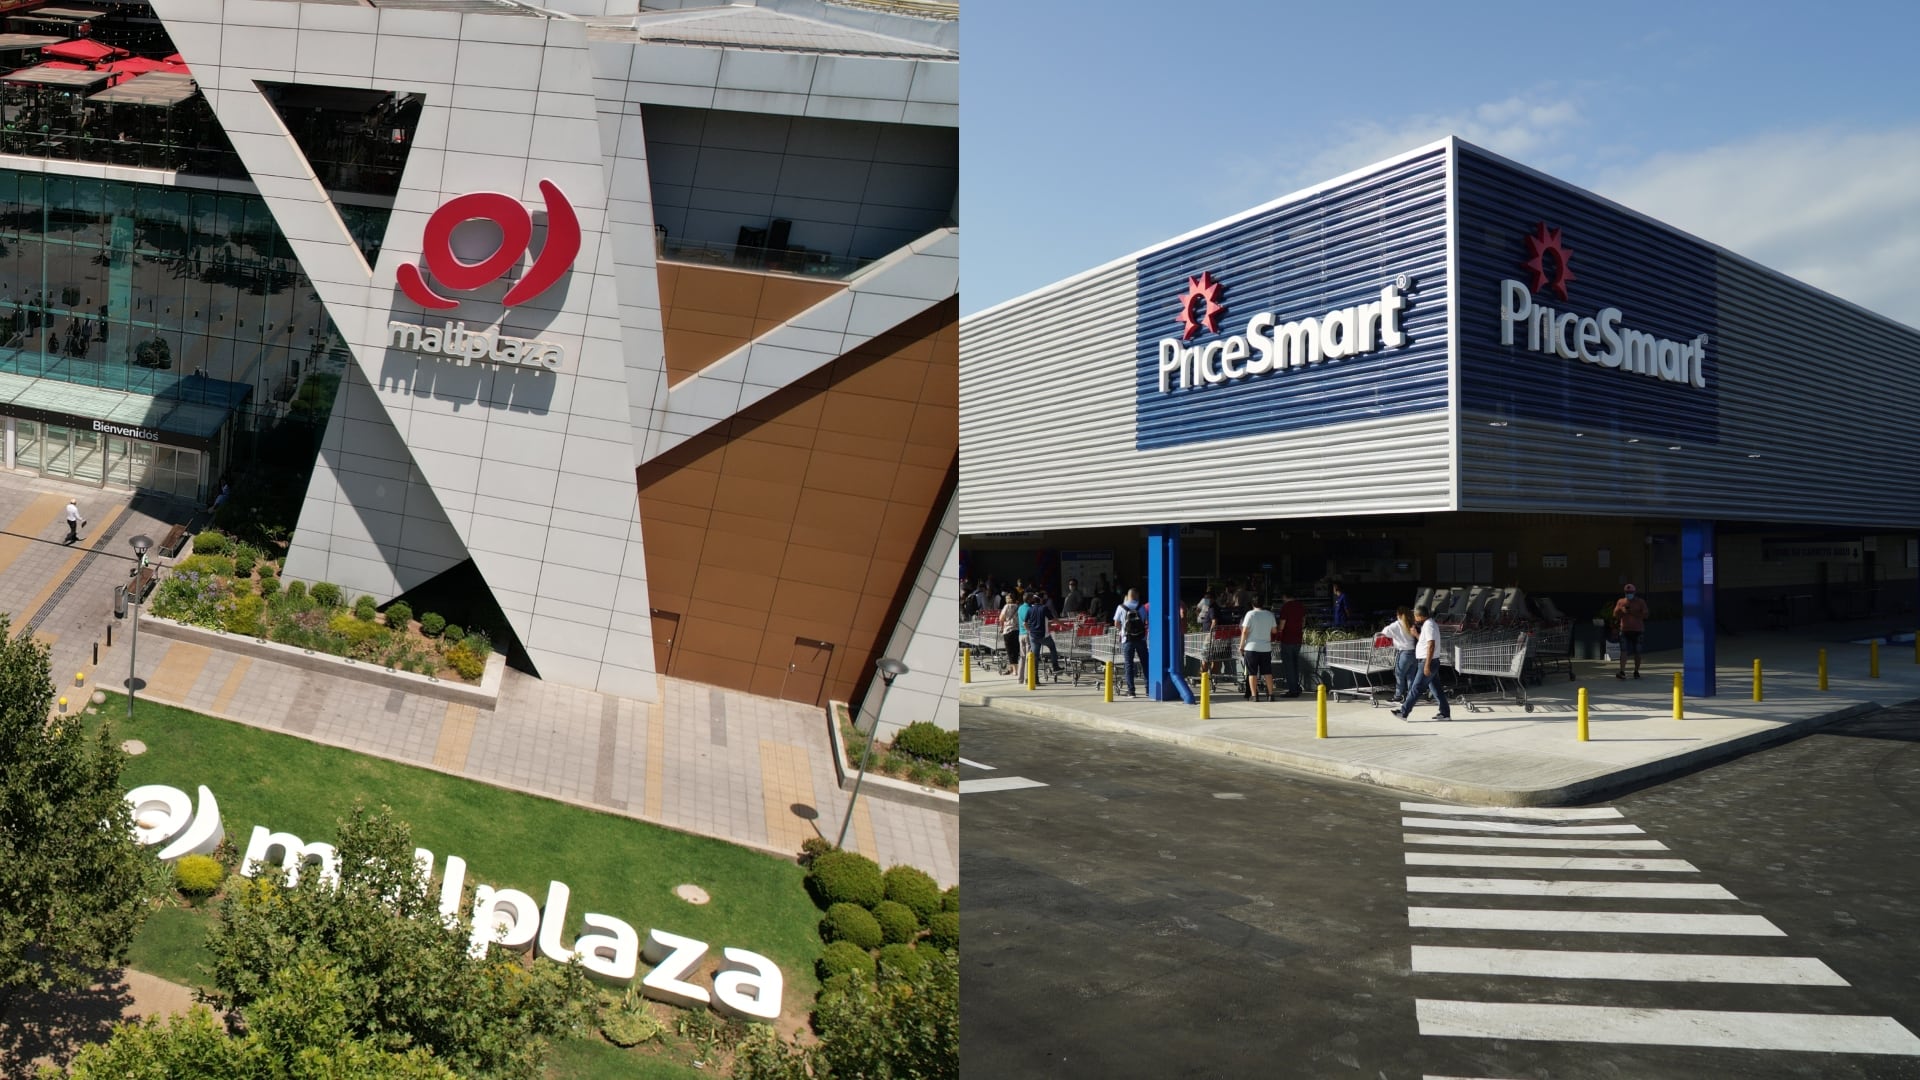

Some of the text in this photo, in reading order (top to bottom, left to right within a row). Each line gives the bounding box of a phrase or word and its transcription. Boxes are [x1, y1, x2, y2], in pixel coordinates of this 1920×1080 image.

[388, 320, 565, 371] mallplaza
[1159, 284, 1407, 393] PriceSmart
[1501, 279, 1706, 388] PriceSmart
[92, 420, 159, 441] Bienvenidos
[240, 825, 783, 1020] mllplaza
